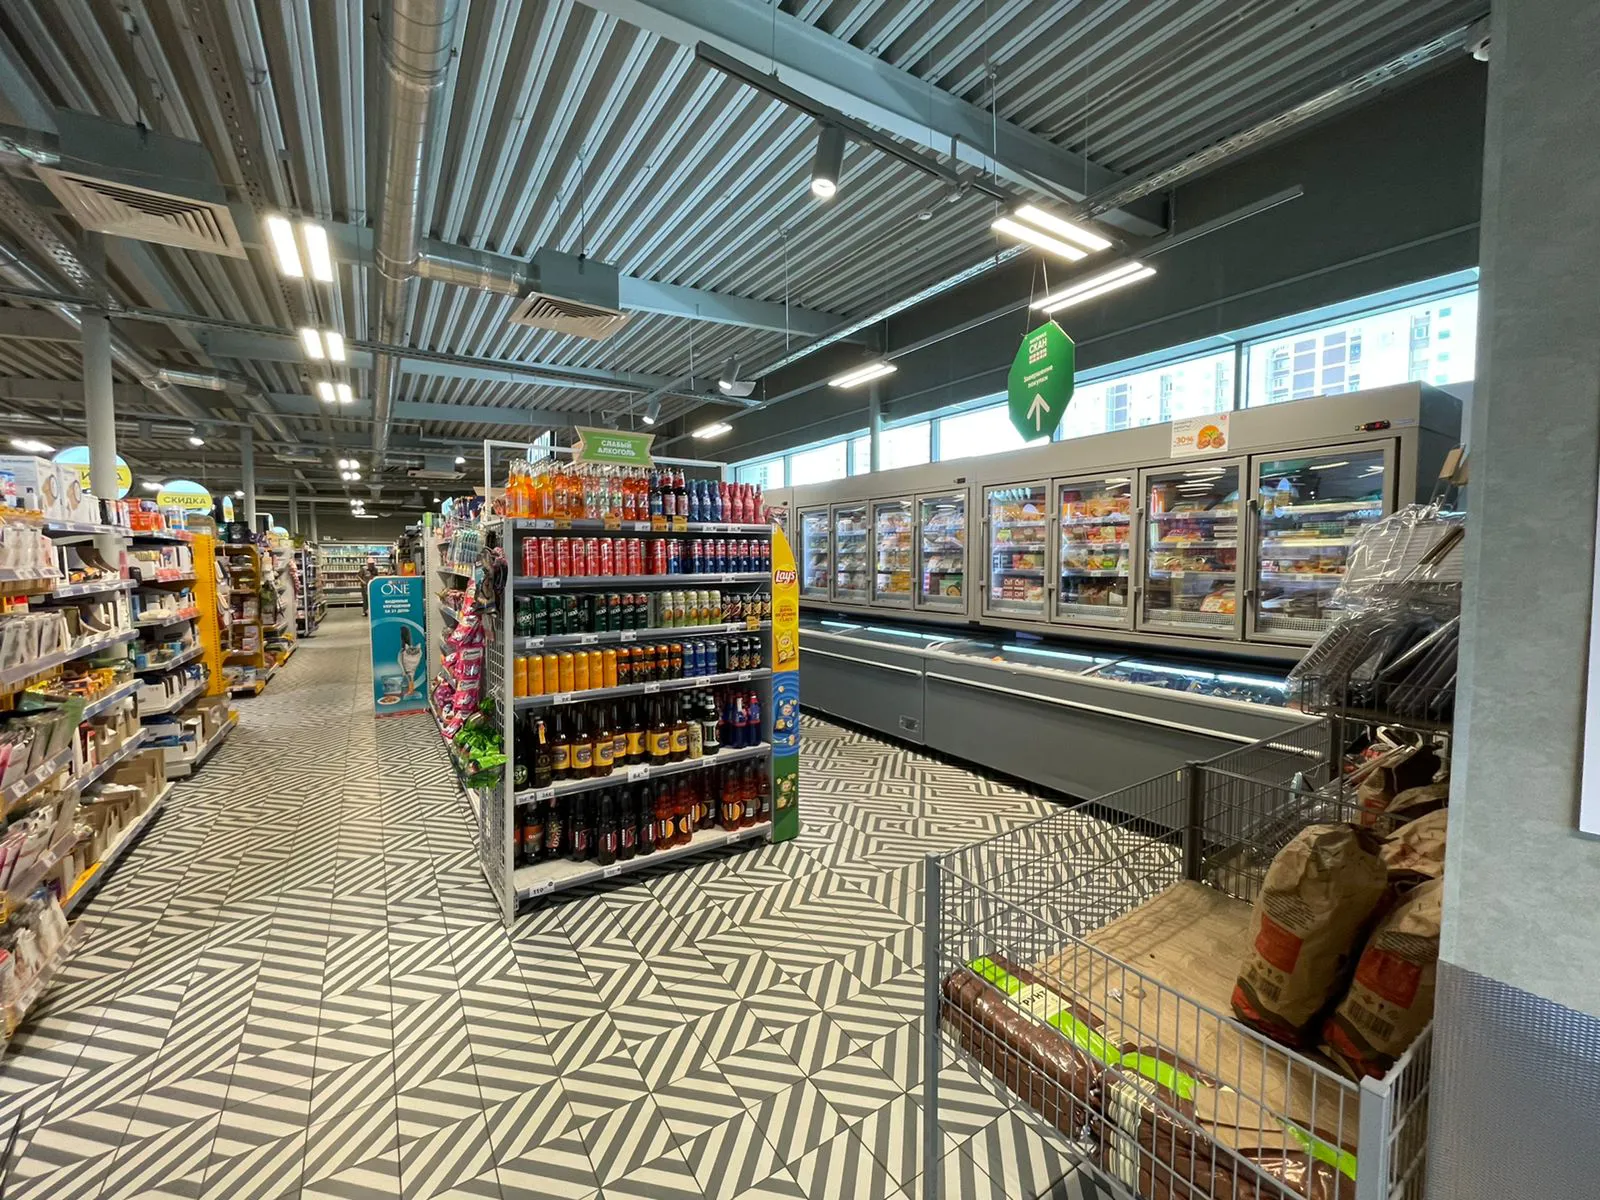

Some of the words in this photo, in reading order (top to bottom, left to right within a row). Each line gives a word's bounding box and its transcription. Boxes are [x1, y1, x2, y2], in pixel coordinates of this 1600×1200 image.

[1029, 336, 1047, 354] СКАН
[601, 440, 632, 449] СЛАБЫЙ
[597, 447, 636, 456] АЛКОГОЛЬ
[163, 496, 207, 505] СКИДКА
[380, 583, 411, 596] ONE
[1018, 990, 1047, 1006] РУНТ
